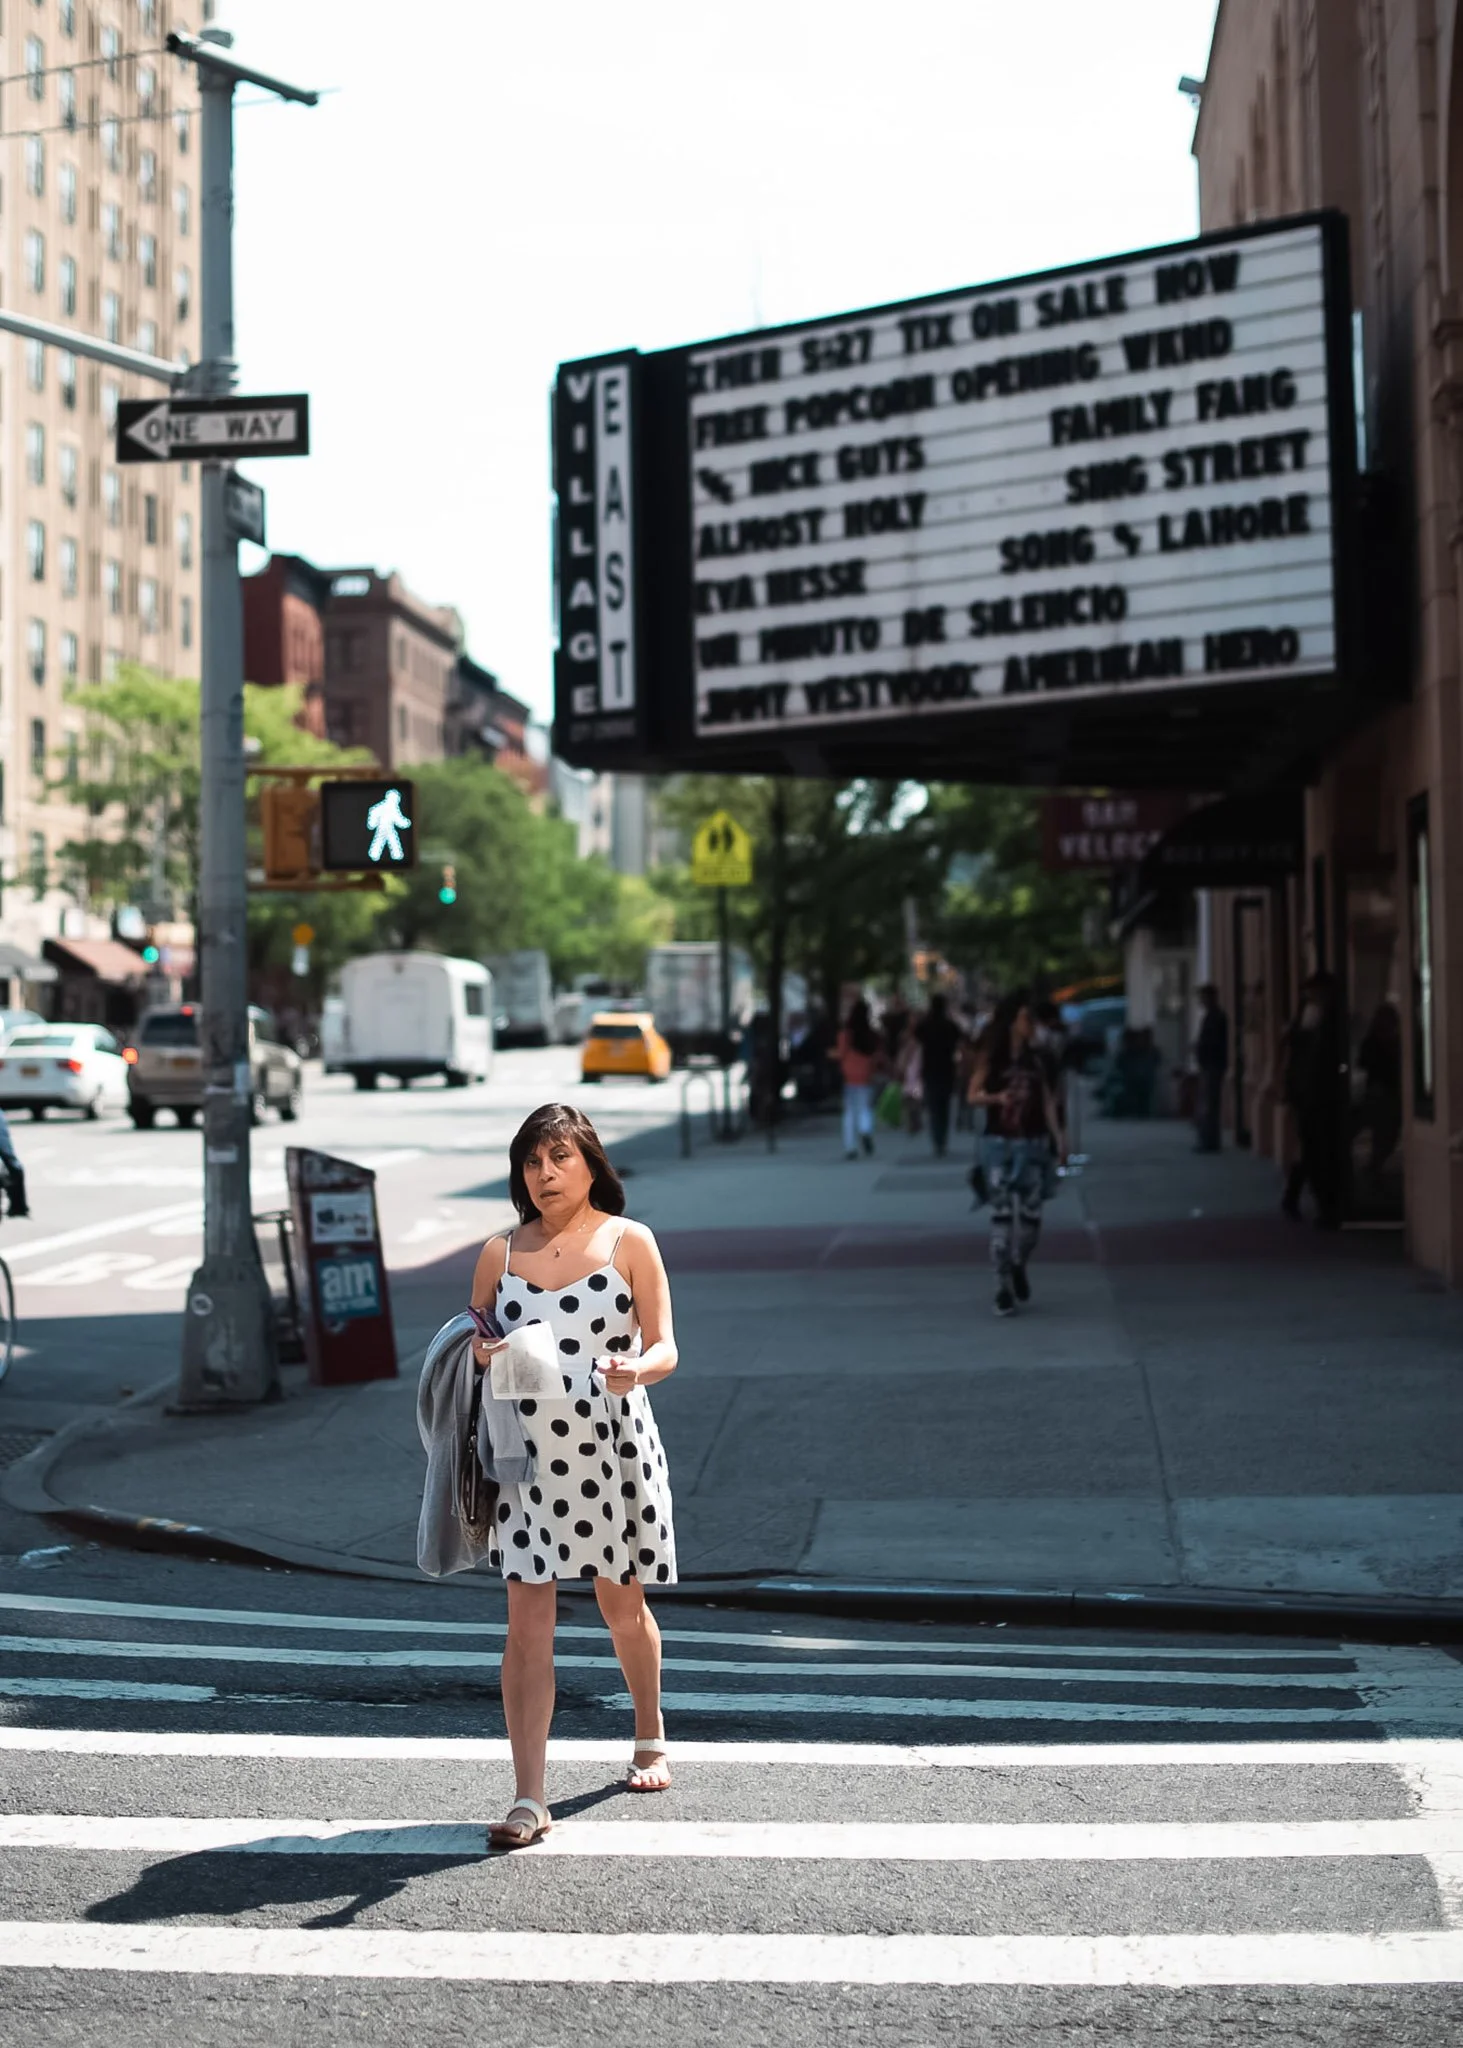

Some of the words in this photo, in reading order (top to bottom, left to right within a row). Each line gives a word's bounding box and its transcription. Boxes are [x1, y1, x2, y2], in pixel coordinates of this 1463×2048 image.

[898, 312, 955, 355] TIX
[972, 298, 1020, 339] ON
[1036, 274, 1129, 330] SALE
[1156, 250, 1242, 304] NOW
[695, 405, 769, 451] FREE
[784, 373, 936, 433] POPCORN
[950, 341, 1100, 403] OPENING
[1121, 317, 1235, 372] WKND
[1050, 388, 1175, 447] FAMILY
[1197, 366, 1298, 422] FANG
[144, 415, 200, 445] ONE
[226, 413, 286, 440] WAY
[749, 450, 822, 497] NICE
[837, 436, 925, 479] GUYS
[1065, 454, 1149, 504] SING
[1163, 430, 1312, 490] STREET
[564, 372, 597, 715] VILLAGE
[602, 378, 628, 700] EAST
[697, 507, 826, 560] ALMOST
[843, 491, 929, 538] HOLY
[1000, 524, 1095, 574] SONG
[1158, 492, 1312, 553] LAHORE
[697, 574, 756, 616] EVA
[766, 558, 869, 606] HESSE
[758, 618, 881, 663] MINUTO
[903, 604, 948, 646] DE
[968, 584, 1129, 638] SILENCIO
[1003, 636, 1184, 694] AMERIKAN
[1205, 626, 1301, 673] HERO
